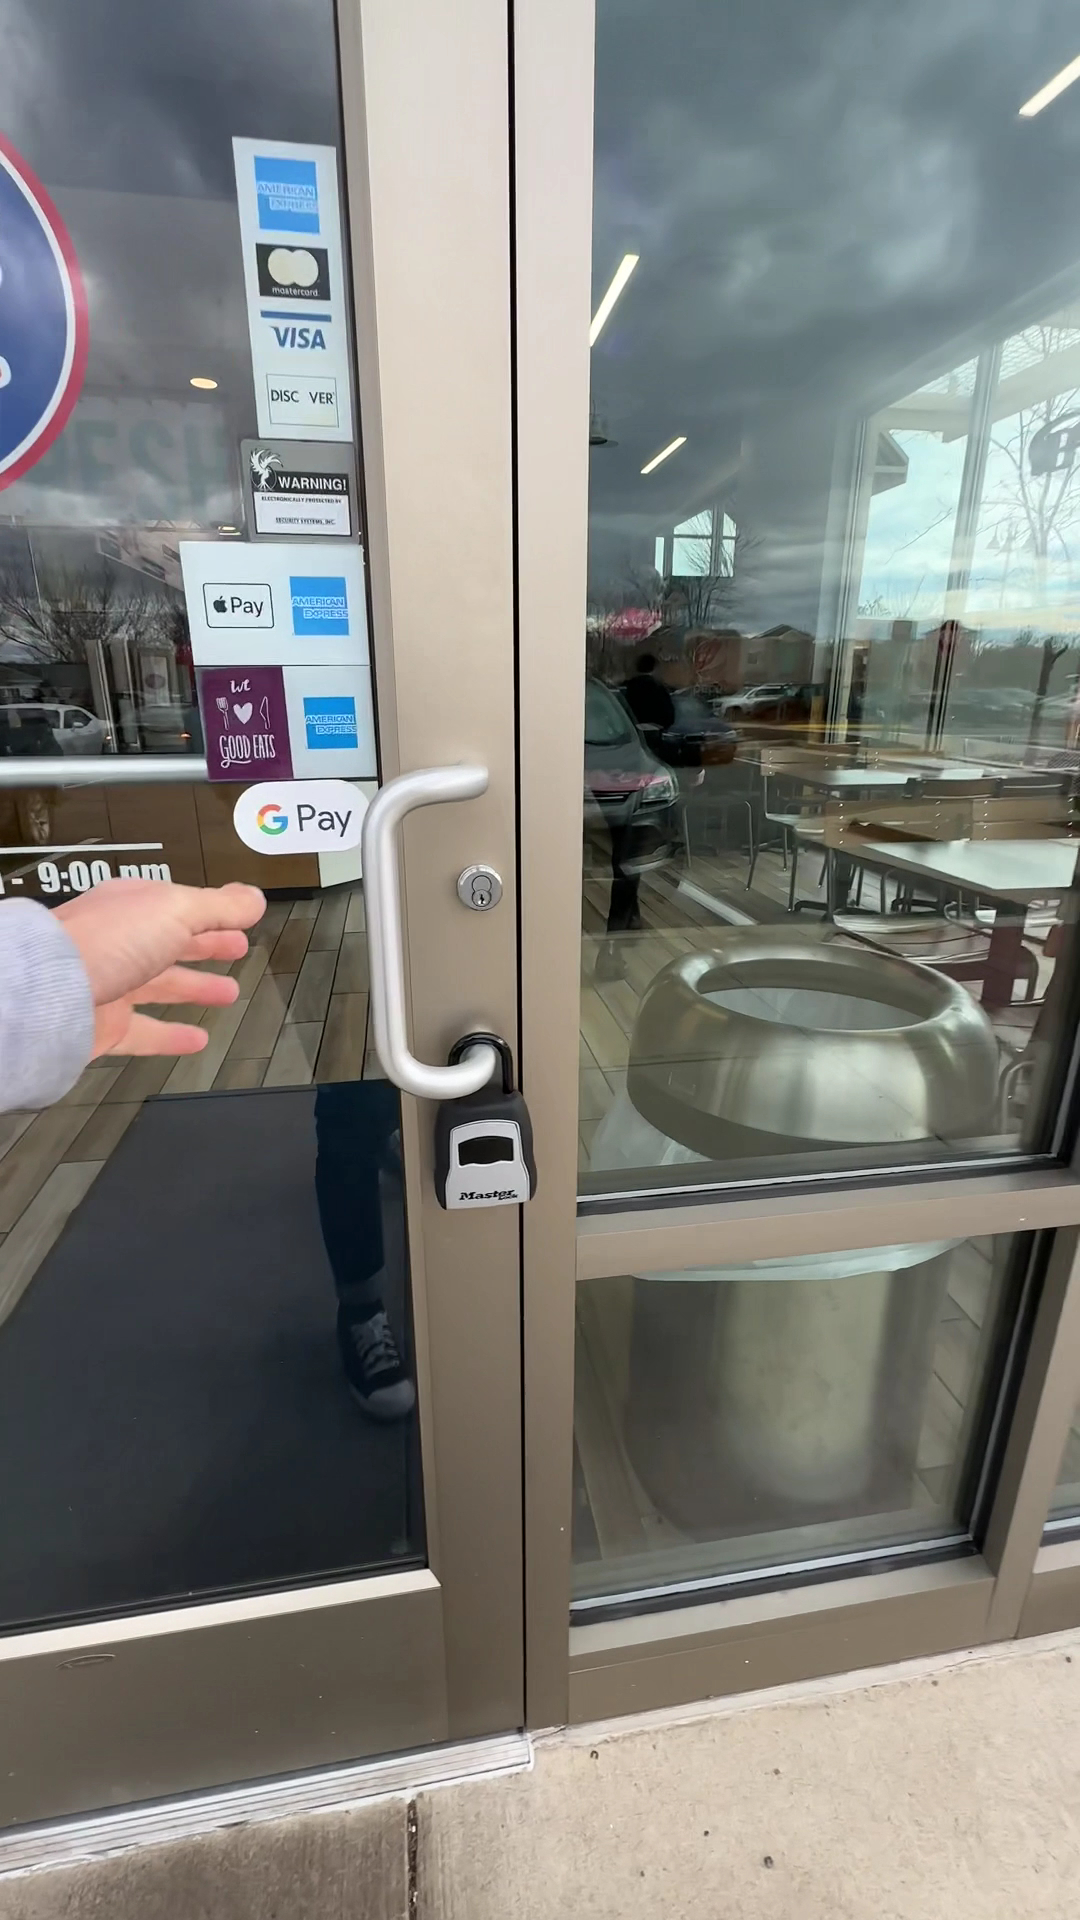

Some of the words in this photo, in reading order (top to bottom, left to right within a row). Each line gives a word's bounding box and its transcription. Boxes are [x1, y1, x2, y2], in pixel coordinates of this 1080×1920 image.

[272, 286, 318, 297] mastercard
[269, 325, 326, 350] VISA
[278, 476, 347, 491] WARNING!
[230, 596, 264, 618] Pay
[291, 597, 345, 607] AMERICAN
[304, 608, 349, 619] EXPRESS
[305, 714, 354, 725] AMERICAN
[316, 725, 357, 735] EXPRESS
[219, 735, 252, 769] GOOD
[253, 734, 276, 759] EATS
[257, 804, 289, 836] G
[297, 804, 352, 838] Pay
[38, 860, 111, 893] 9:00
[459, 1190, 515, 1201] Master
